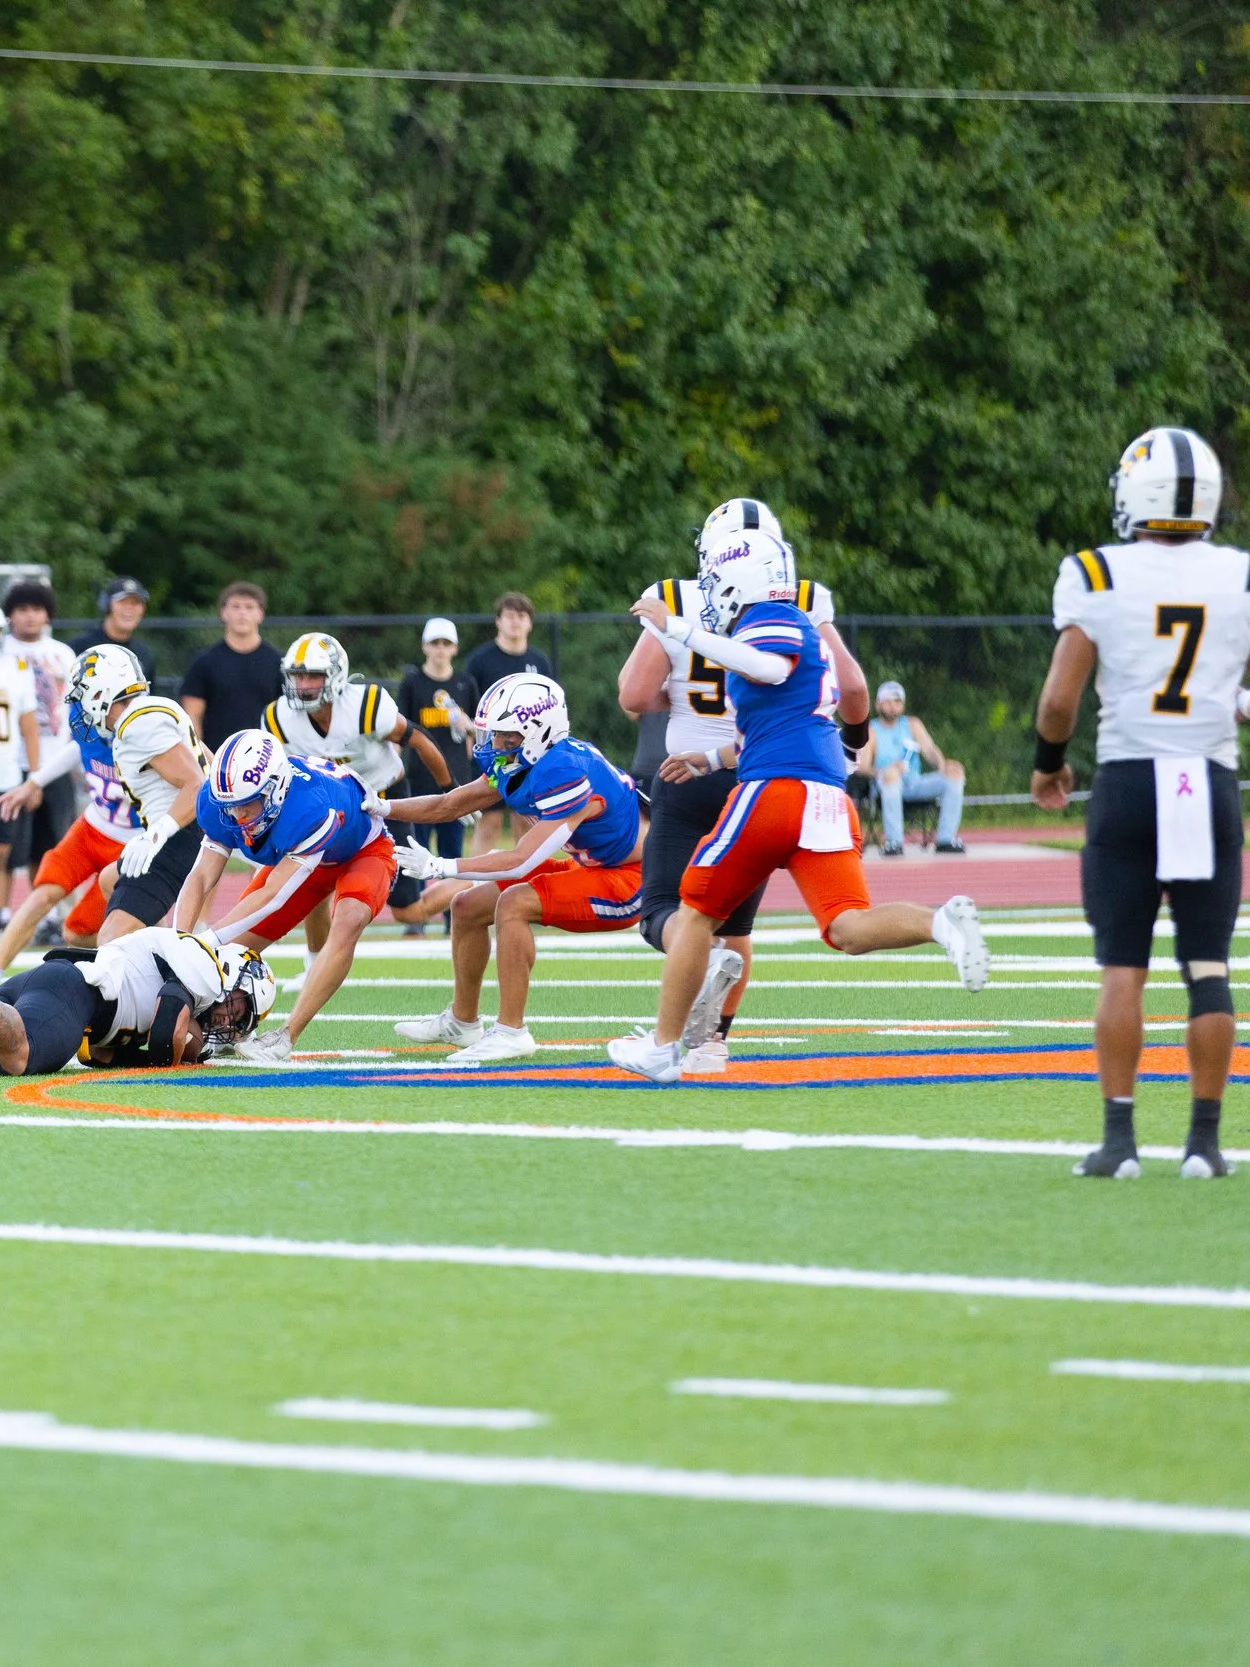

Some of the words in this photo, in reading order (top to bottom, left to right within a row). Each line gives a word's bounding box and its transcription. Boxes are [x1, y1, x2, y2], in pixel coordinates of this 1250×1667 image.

[1151, 602, 1207, 716] 7
[517, 694, 558, 724] Bruins
[242, 738, 275, 786] Bruins
